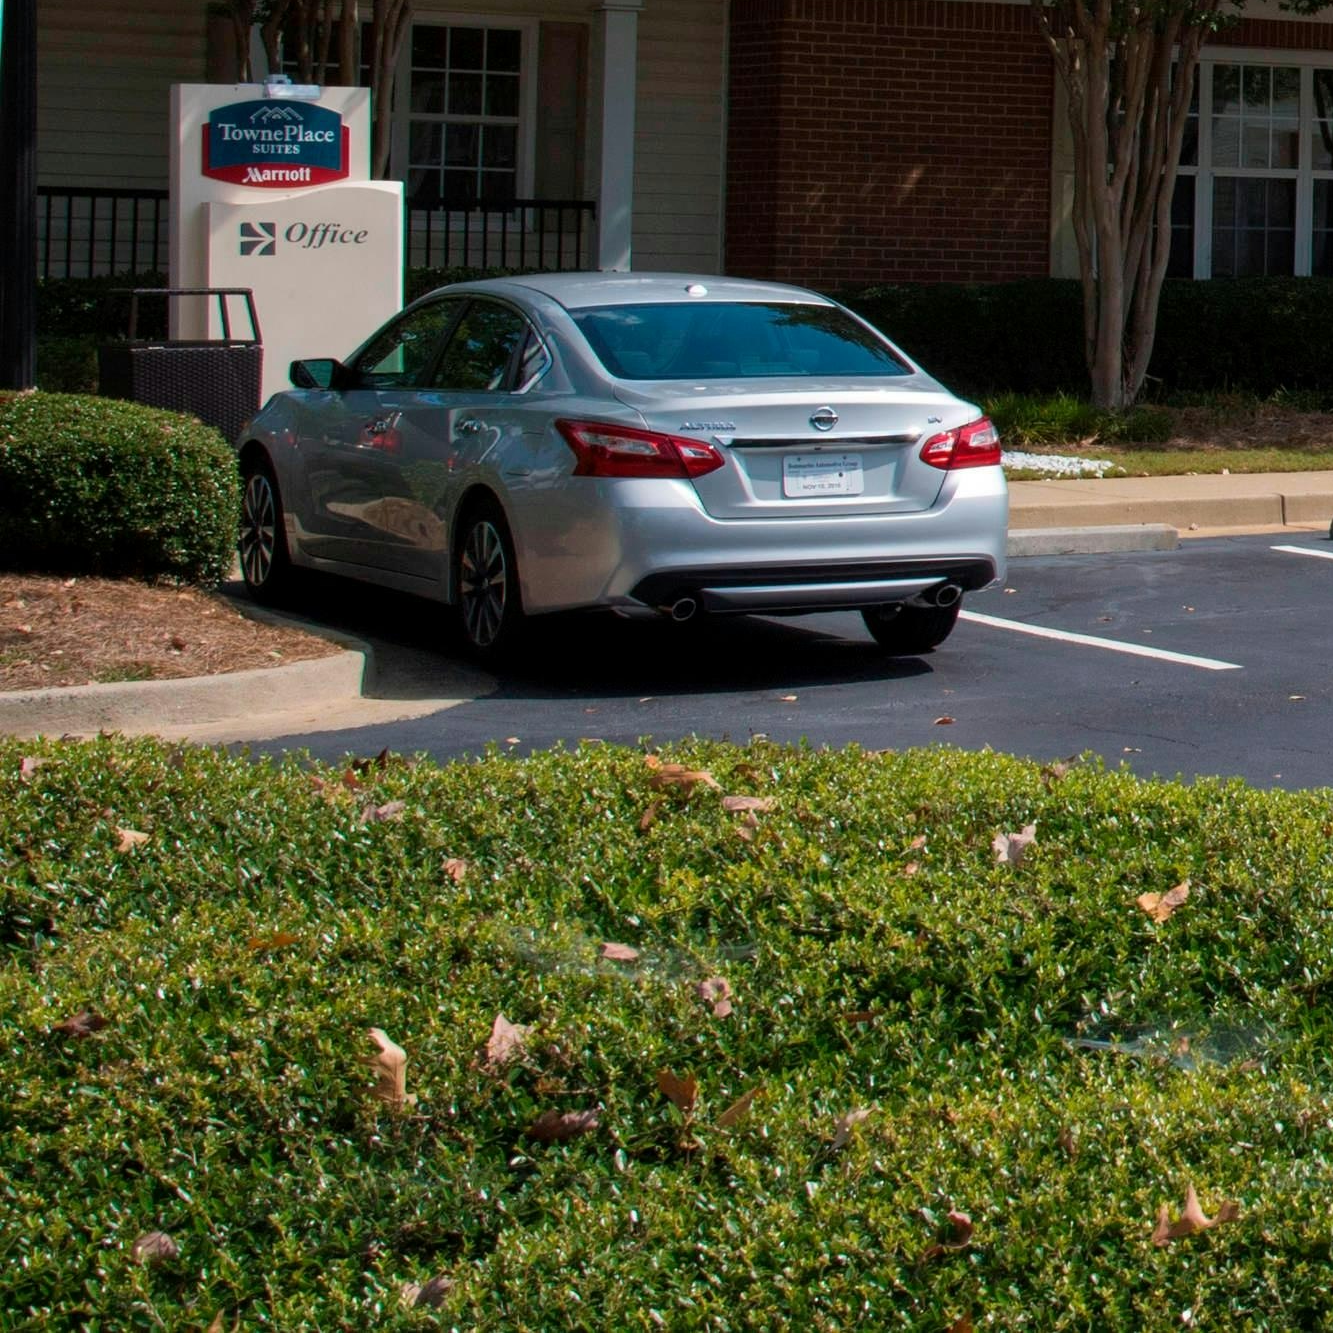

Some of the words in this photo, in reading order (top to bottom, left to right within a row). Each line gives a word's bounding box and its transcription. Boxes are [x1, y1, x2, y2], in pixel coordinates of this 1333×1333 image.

[218, 123, 335, 143] TownePlace
[252, 143, 301, 155] SUITES
[241, 166, 312, 184] Marriott
[284, 221, 369, 249] Office
